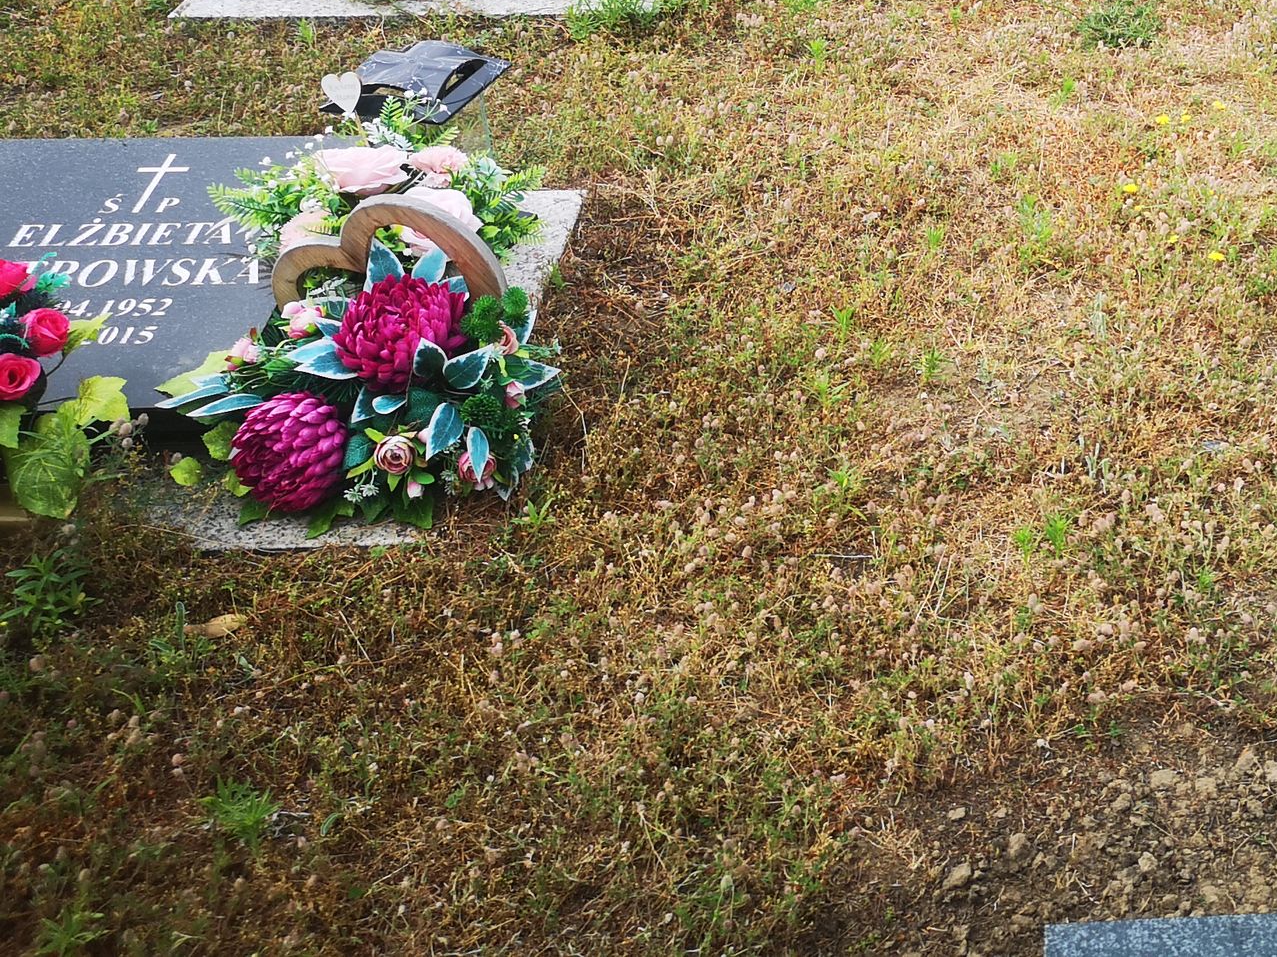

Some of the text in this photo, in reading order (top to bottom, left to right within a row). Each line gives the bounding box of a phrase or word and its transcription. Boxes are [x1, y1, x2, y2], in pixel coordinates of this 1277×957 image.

[98, 194, 181, 213] Ś P
[7, 218, 234, 248] ELŻBIETA
[80, 326, 159, 346] 015
